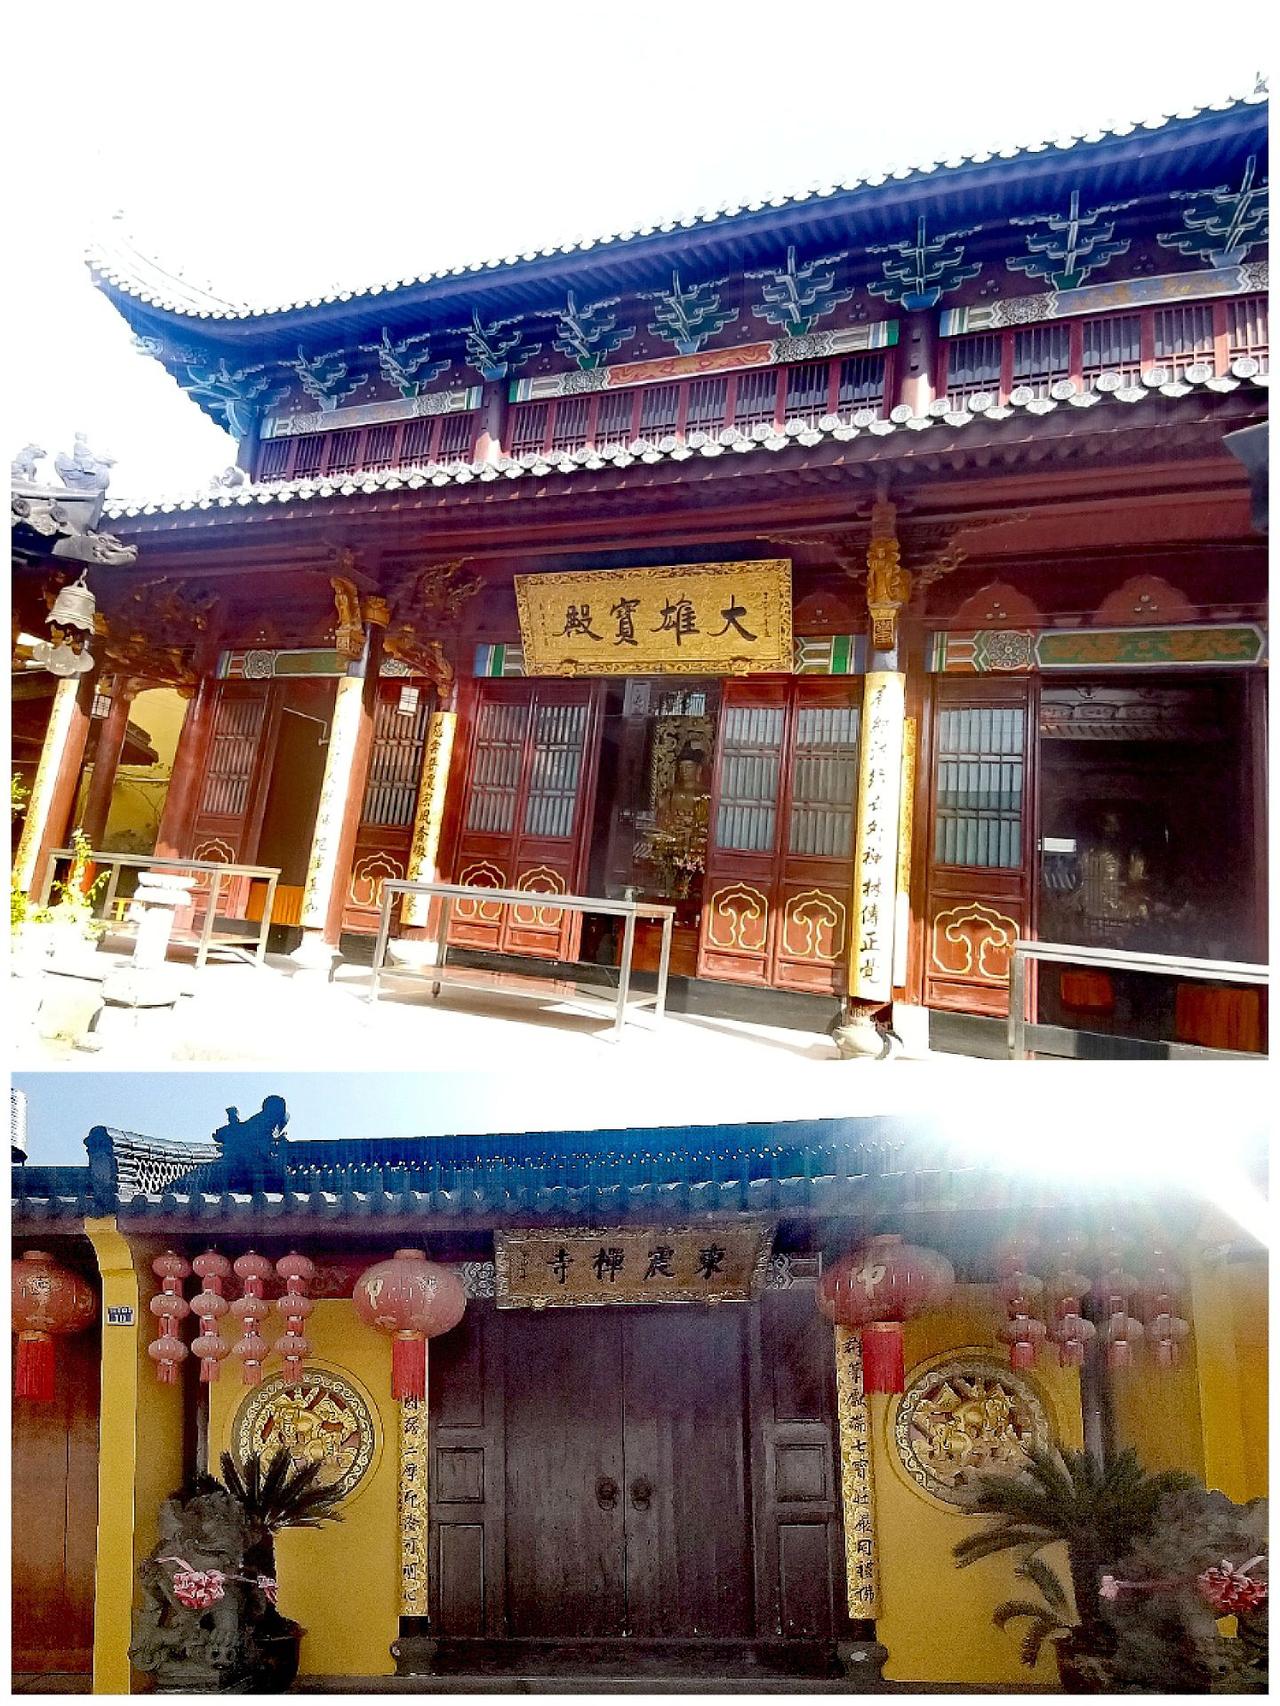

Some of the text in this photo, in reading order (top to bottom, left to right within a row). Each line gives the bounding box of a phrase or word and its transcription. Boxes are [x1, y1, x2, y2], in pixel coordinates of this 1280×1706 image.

[552, 593, 758, 646] 大雄寶殿
[546, 1243, 727, 1285] 東震禪寺
